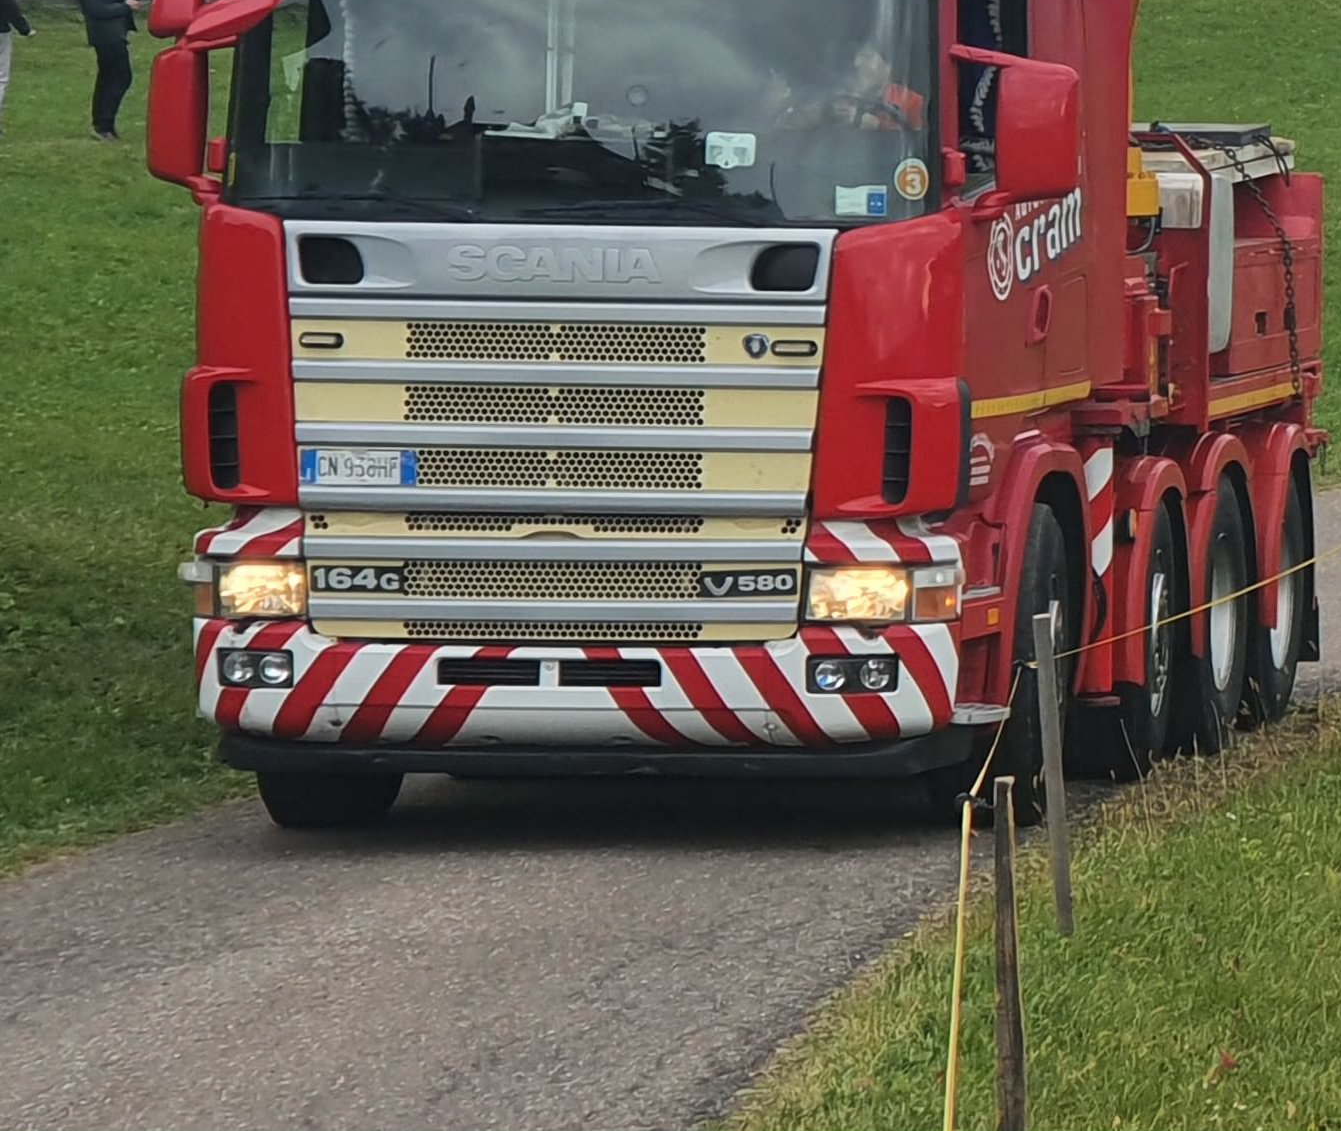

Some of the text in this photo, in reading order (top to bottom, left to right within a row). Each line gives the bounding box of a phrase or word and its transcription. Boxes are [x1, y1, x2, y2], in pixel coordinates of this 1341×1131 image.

[1015, 186, 1081, 281] cram
[449, 244, 662, 284] SCANIA
[318, 456, 338, 477] CN
[737, 574, 794, 592] 580
